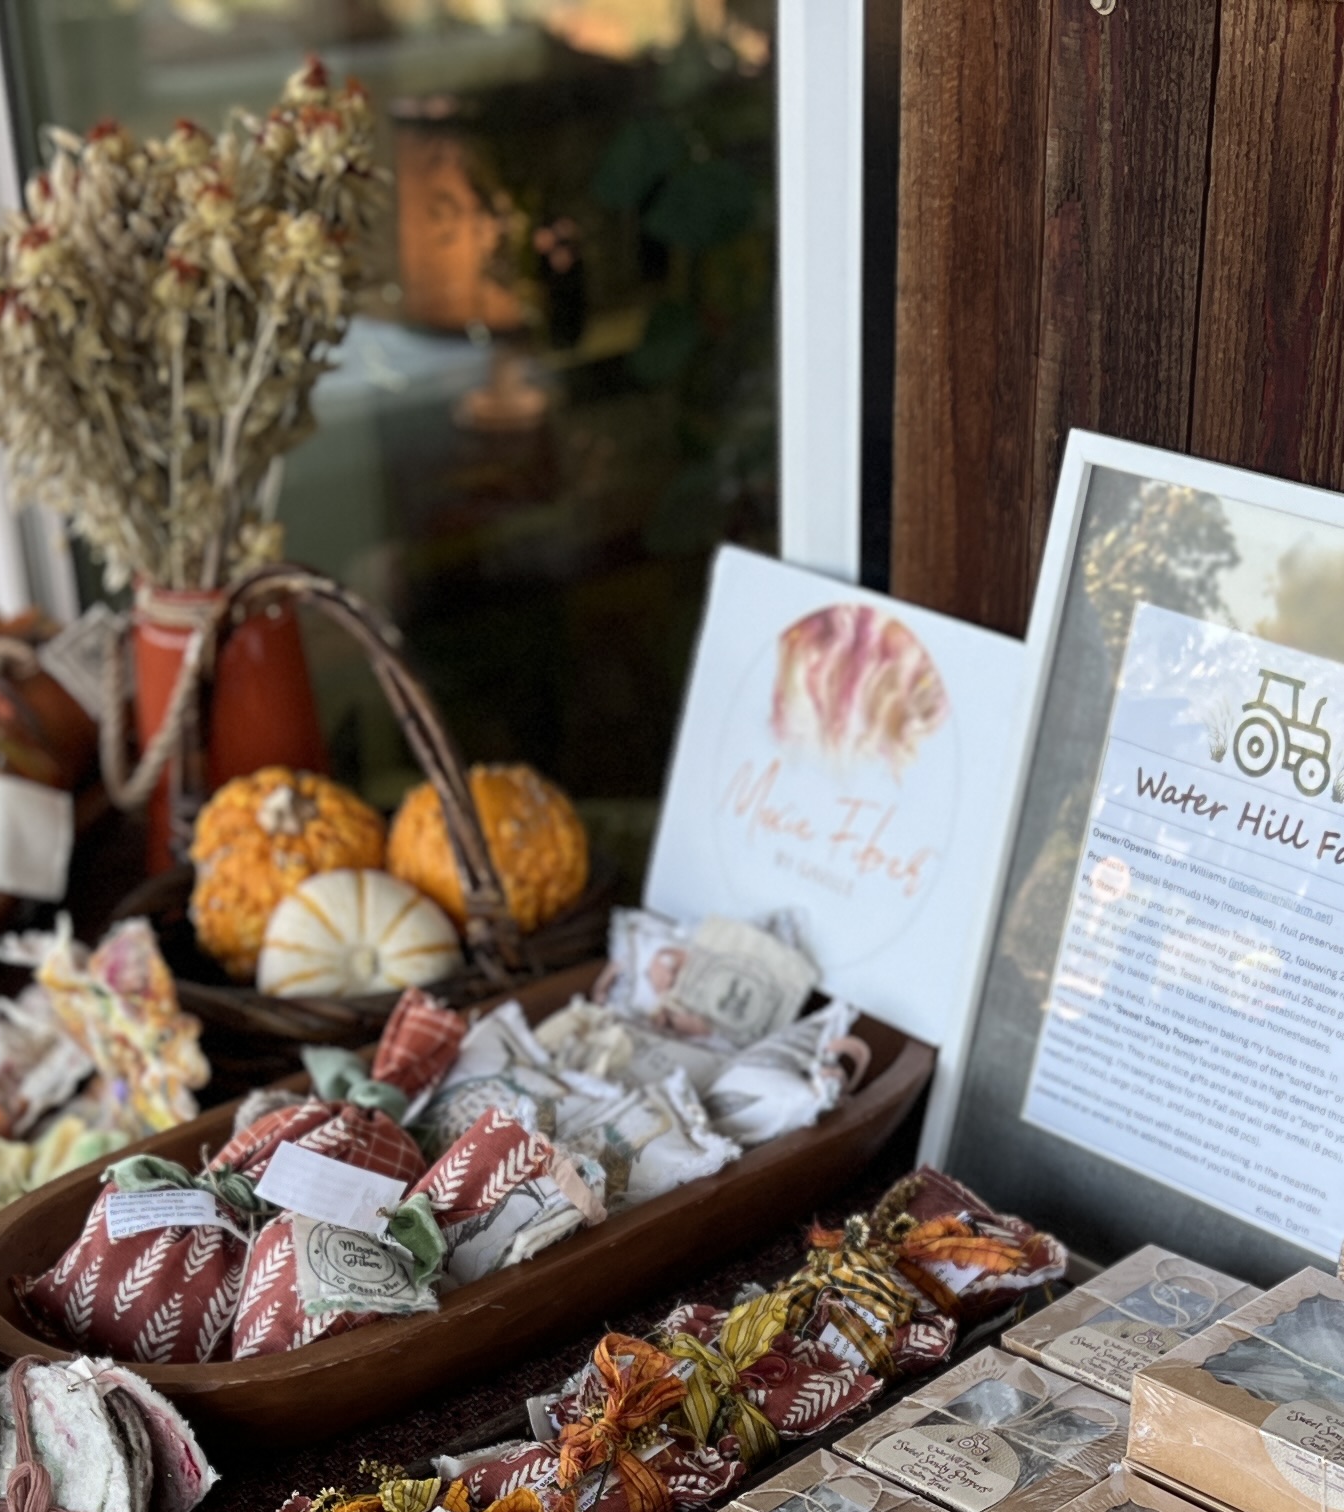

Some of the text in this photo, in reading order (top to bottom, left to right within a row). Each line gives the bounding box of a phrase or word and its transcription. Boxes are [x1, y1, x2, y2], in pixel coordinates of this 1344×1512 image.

[1136, 765, 1229, 821] Water
[1235, 800, 1310, 850] Hill
[1091, 827, 1163, 861] Owner/Operator:
[1163, 853, 1188, 870] Darin
[1188, 862, 1227, 885] Williams
[1081, 873, 1094, 889] My
[1146, 900, 1173, 916] proud
[1185, 915, 1230, 938] generation
[1294, 954, 1337, 982] following
[1127, 865, 1161, 886] Coastal
[1161, 877, 1201, 901] Bermuda
[1201, 892, 1219, 911] Hay
[1279, 921, 1299, 938] fruit
[1127, 930, 1174, 954] manifested
[1240, 972, 1250, 984] to
[1251, 978, 1258, 987] a
[1259, 980, 1300, 1004] beautiful
[1300, 996, 1335, 1017] 26-acre
[1132, 913, 1159, 930] nation
[1160, 924, 1217, 952] characterized
[1217, 944, 1228, 959] by
[1282, 971, 1301, 984] and
[1301, 978, 1337, 998] shallow
[1114, 943, 1135, 957] west
[1135, 951, 1144, 961] of
[1210, 979, 1230, 995] took
[1230, 989, 1250, 1003] over
[1251, 997, 1264, 1009] an
[1264, 1002, 1317, 1029] established
[1316, 1021, 1334, 1039] hay
[1171, 1026, 1208, 1047] Popper"
[1218, 1027, 1249, 1050] baking
[1249, 1041, 1263, 1056] my
[1264, 1046, 1298, 1067] favorite
[1247, 1015, 1265, 1029] and
[1266, 1021, 1330, 1055] homesteaders.
[1283, 1218, 1309, 1237] Darin
[918, 1454, 950, 1475] Sandy
